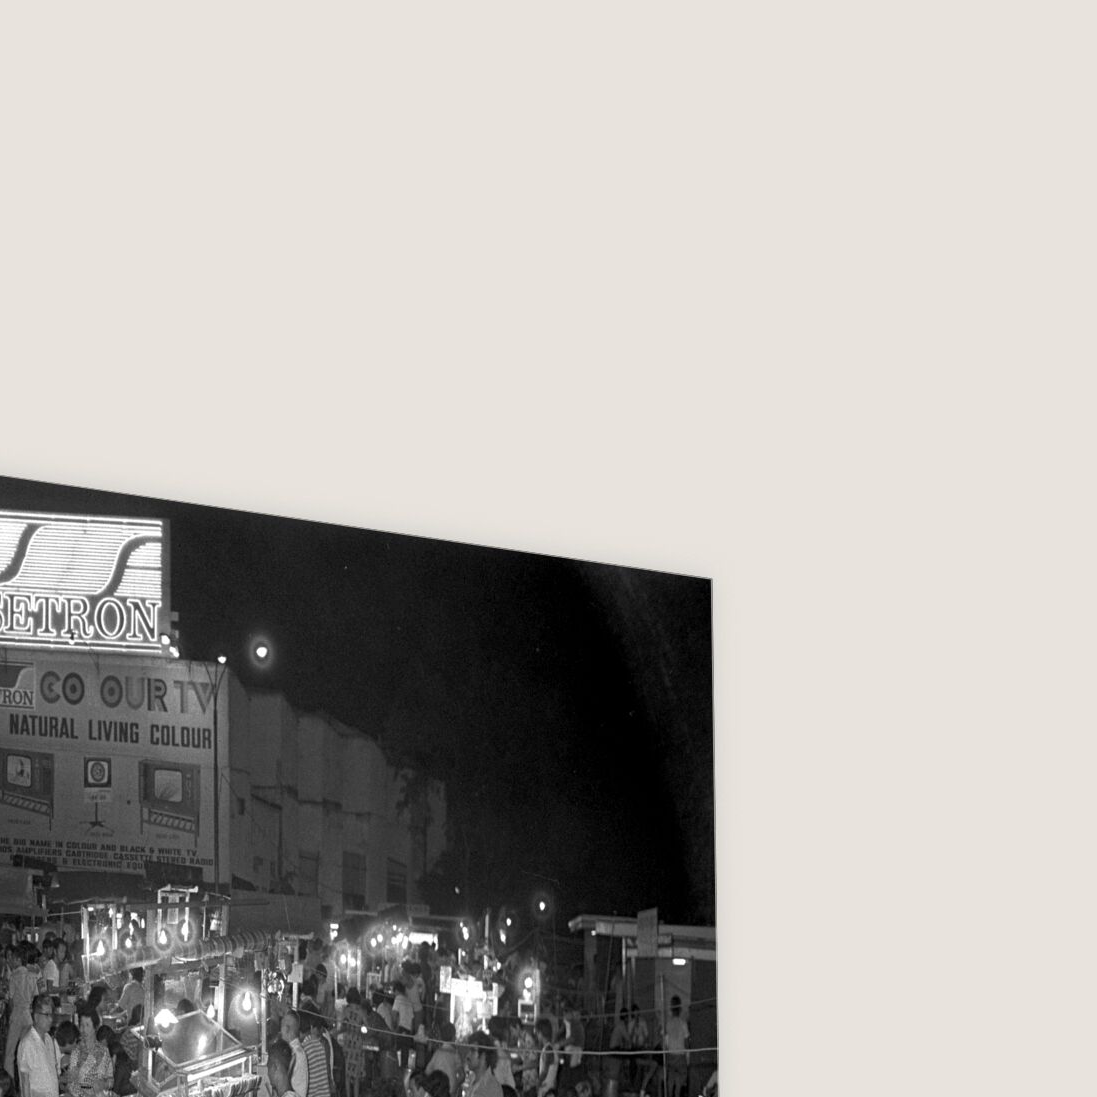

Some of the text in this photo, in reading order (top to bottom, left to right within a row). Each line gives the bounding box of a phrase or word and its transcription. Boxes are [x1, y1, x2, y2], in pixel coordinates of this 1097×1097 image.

[39, 670, 215, 714] COOUR TV
[9, 713, 79, 740] NATURAL
[88, 719, 139, 744] LIVING
[150, 724, 212, 749] COLOUR
[13, 838, 26, 846] BIG
[30, 839, 52, 848] NAME
[55, 840, 63, 848] IN
[66, 841, 97, 850] COLOUR
[100, 844, 117, 852] AND
[119, 845, 146, 853] BLACK
[157, 847, 182, 856] WHITE
[16, 846, 62, 856] AMPLIFIERS
[113, 853, 152, 863] CASSETTE
[156, 855, 186, 865] STEREO
[189, 857, 214, 866] RADIO
[72, 858, 122, 869] ELECTRONIC
